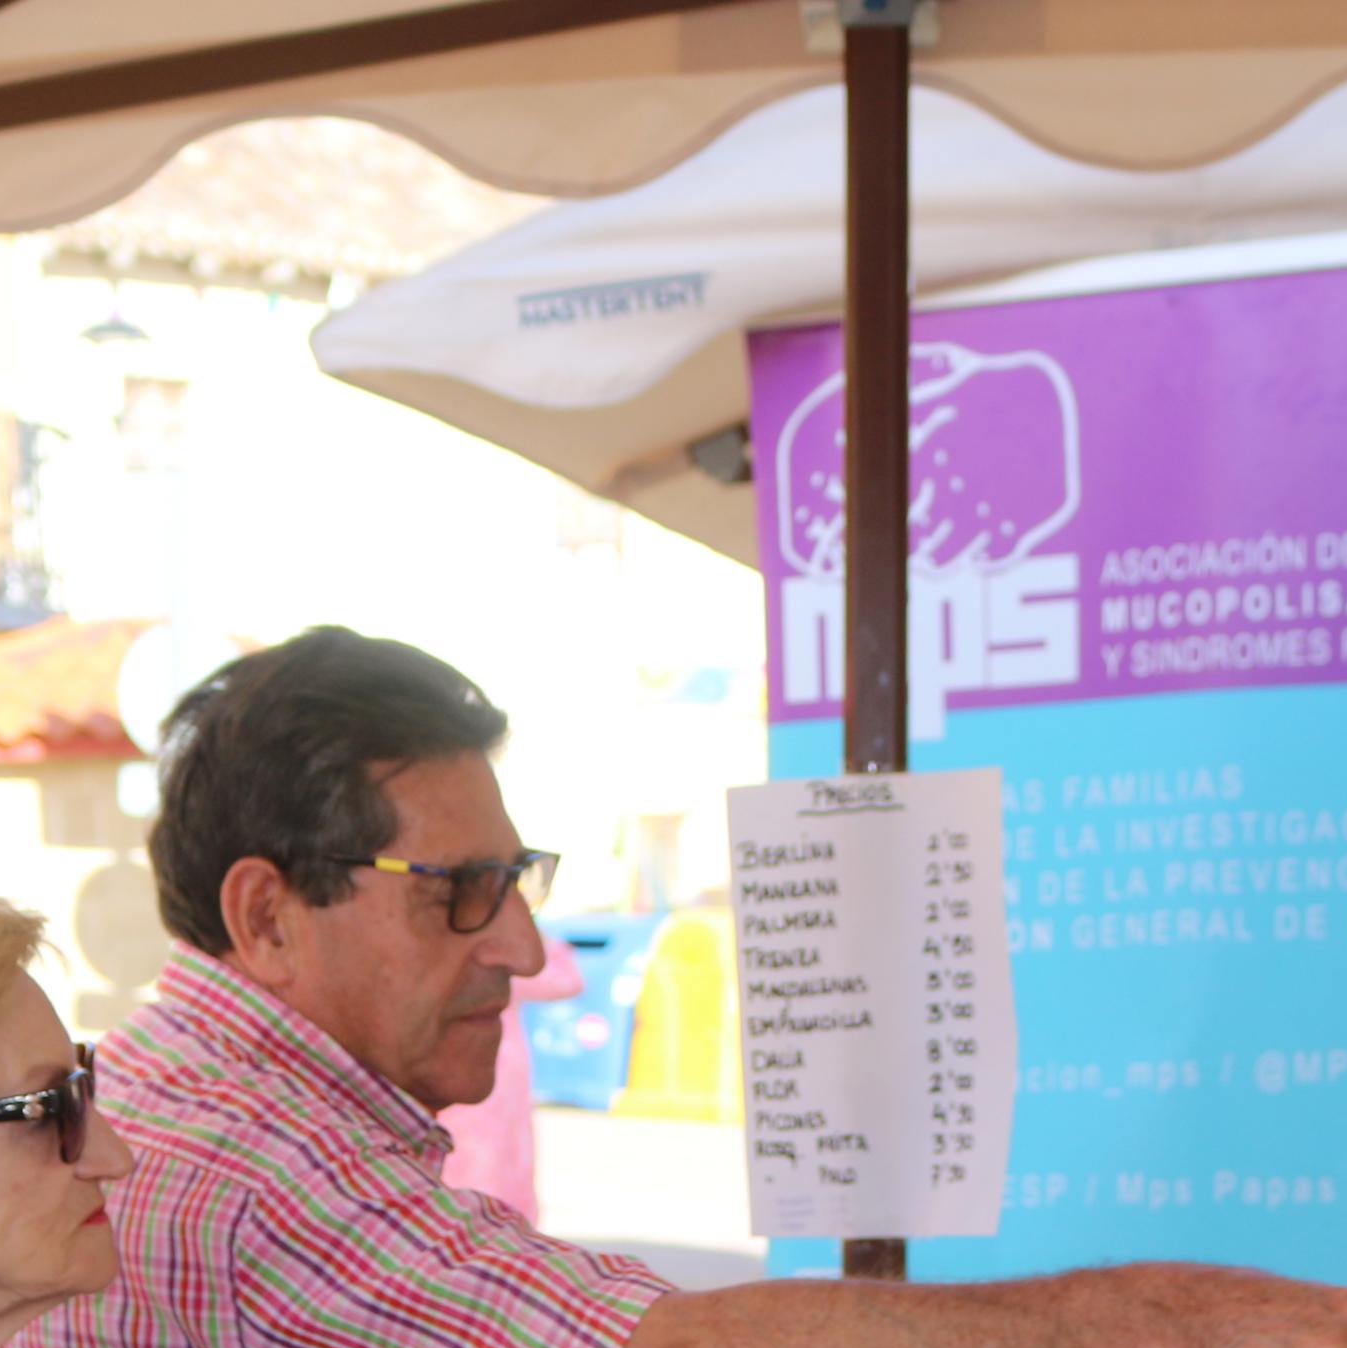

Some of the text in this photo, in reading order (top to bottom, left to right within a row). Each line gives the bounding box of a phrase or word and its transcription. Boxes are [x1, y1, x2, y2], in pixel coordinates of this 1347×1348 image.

[518, 273, 710, 327] MASTERTENT
[1100, 529, 1307, 586] ASOCIACIÓN
[1101, 644, 1125, 680] Y
[1002, 763, 1245, 814] AS FAMILIAS
[1054, 822, 1101, 859] LA
[1038, 868, 1086, 906] DE
[1104, 866, 1150, 902] LA
[1072, 906, 1253, 950] GENERAL
[1274, 903, 1328, 941] DE
[1018, 1060, 1201, 1099] cion_mps
[1116, 1171, 1193, 1210] Mps
[1213, 1169, 1337, 1210] Papas
